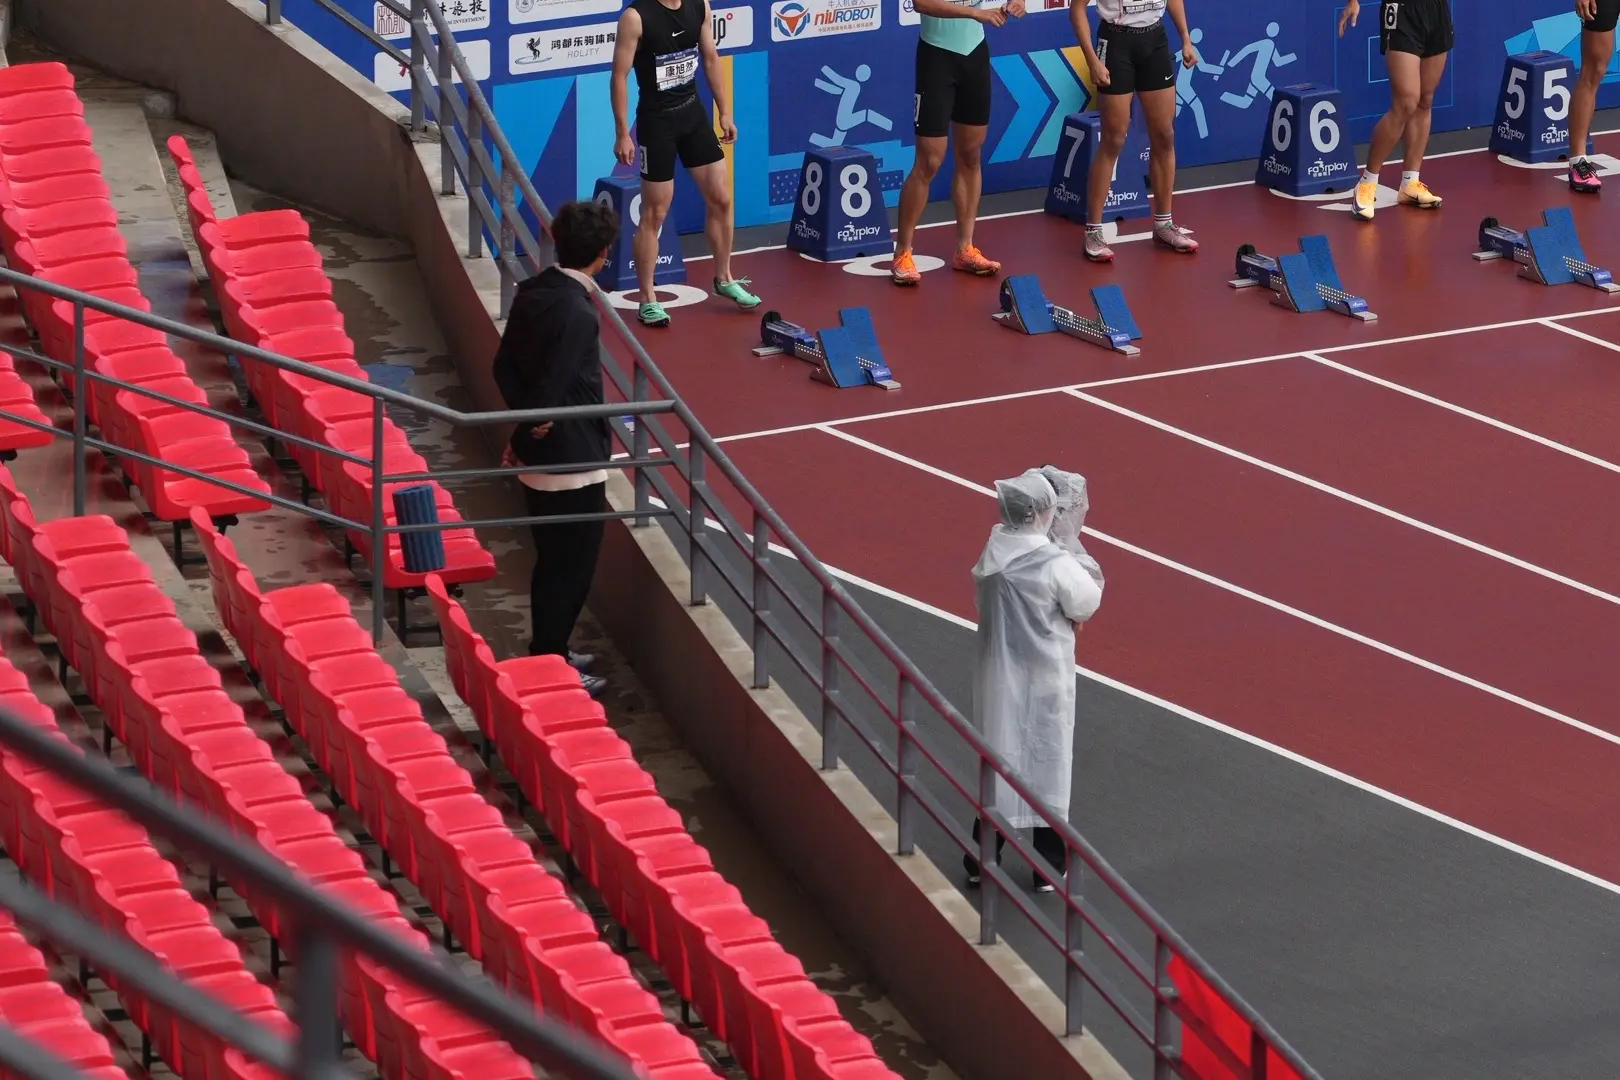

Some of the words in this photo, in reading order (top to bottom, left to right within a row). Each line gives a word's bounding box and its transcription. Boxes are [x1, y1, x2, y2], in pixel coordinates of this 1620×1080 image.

[551, 32, 616, 50] 鸿都乐驹体育
[1386, 5, 1396, 27] 6
[665, 61, 694, 78] 康旭然
[1504, 67, 1528, 120] 5
[1543, 67, 1571, 121] 5
[1063, 125, 1086, 178] 7
[1272, 99, 1294, 152] 6
[1309, 100, 1340, 153] 6
[802, 161, 823, 216] 8
[840, 164, 872, 218] 8
